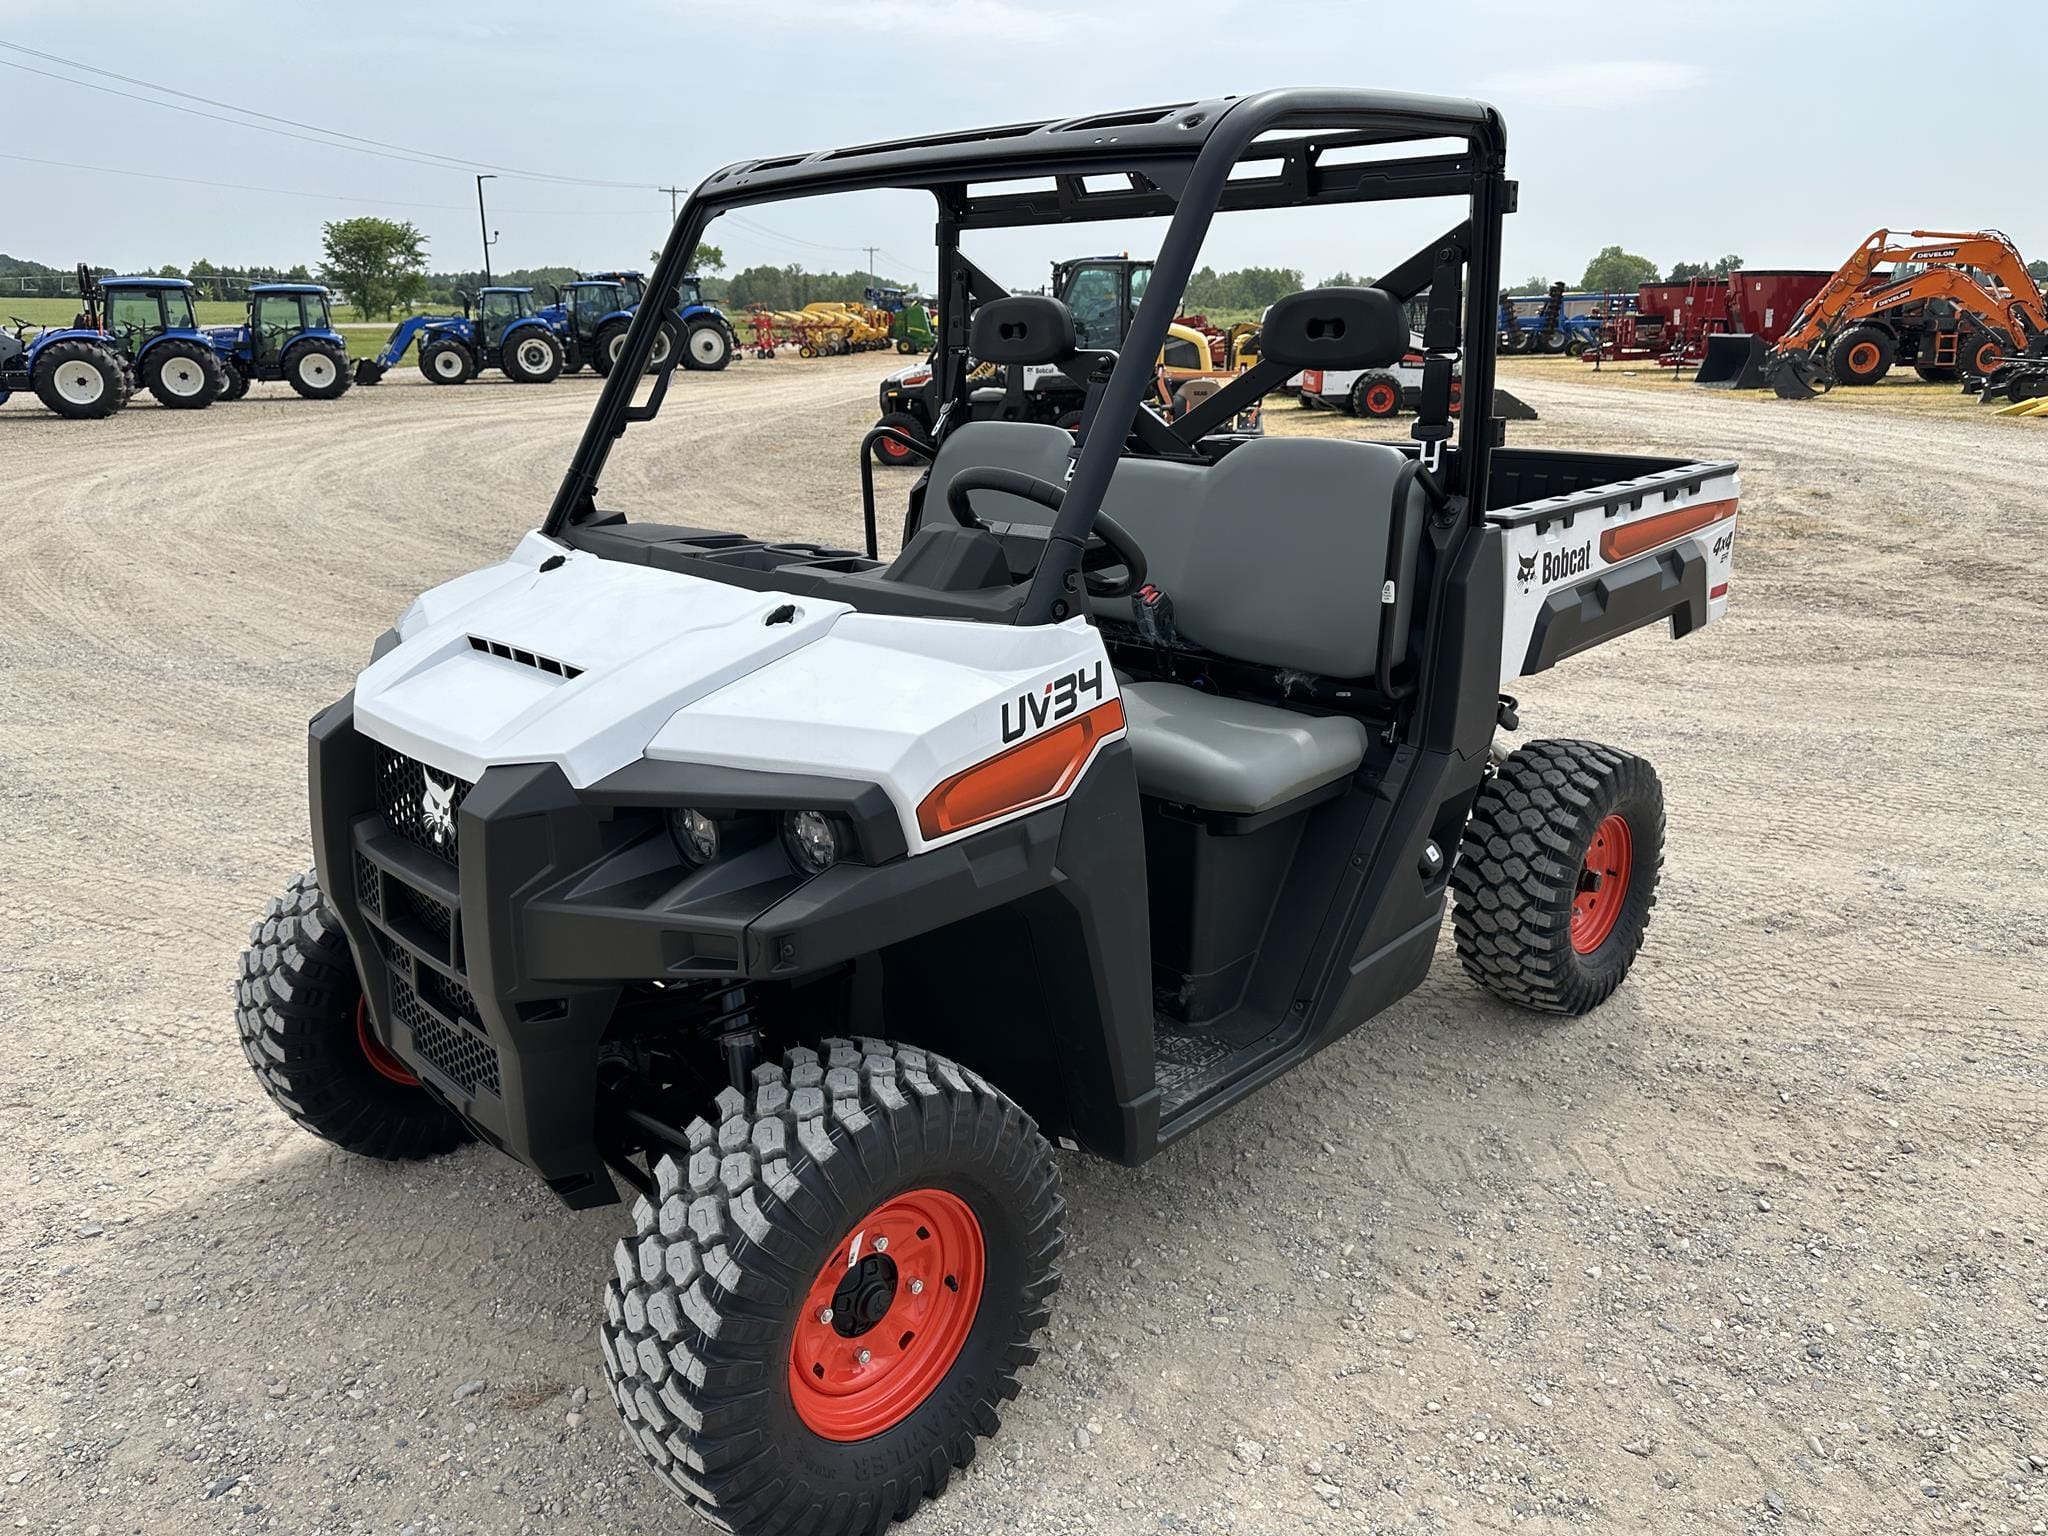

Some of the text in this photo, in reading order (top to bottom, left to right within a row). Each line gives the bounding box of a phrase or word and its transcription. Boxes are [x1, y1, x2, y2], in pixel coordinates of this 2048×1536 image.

[1917, 250, 1955, 259] DEVELON
[1878, 290, 1910, 307] DEVELON
[1713, 530, 1733, 556] 4x4
[1542, 540, 1591, 585] Bobcat
[1001, 660, 1102, 744] UV34
